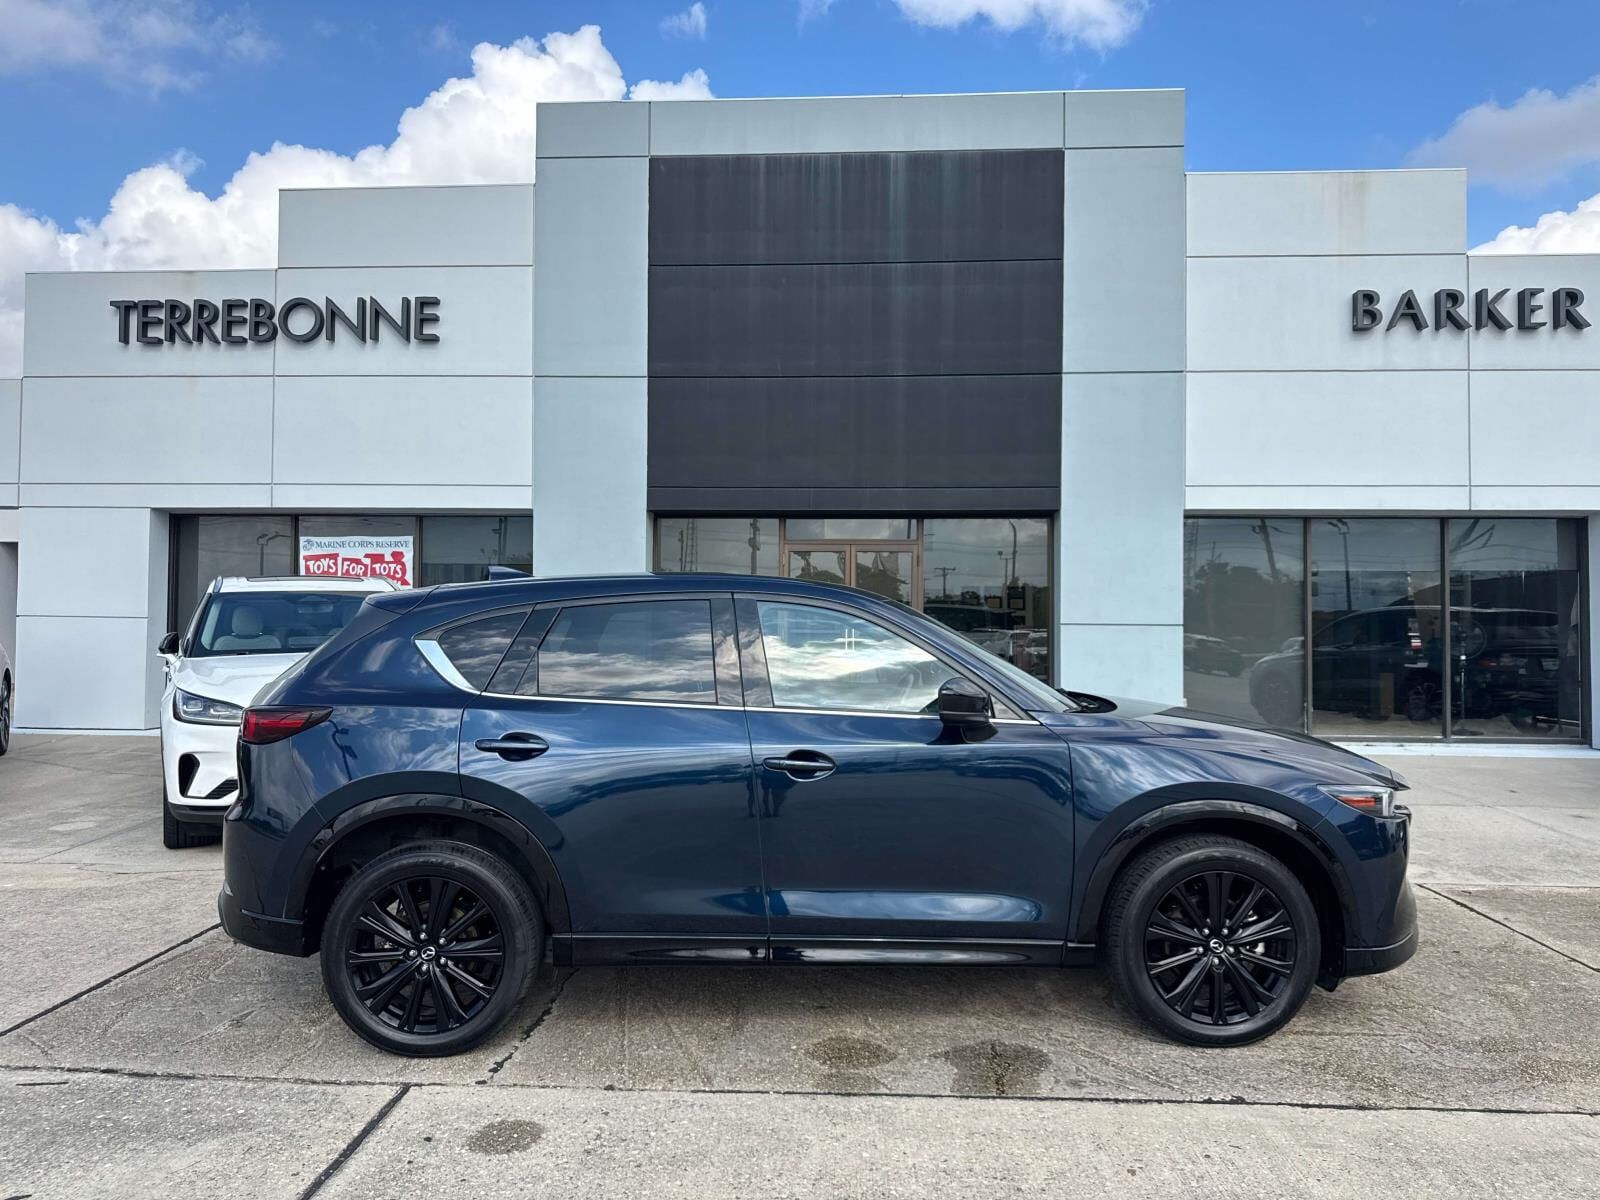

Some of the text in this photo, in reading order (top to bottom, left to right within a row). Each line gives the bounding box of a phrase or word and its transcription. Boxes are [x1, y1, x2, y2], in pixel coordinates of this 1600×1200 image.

[110, 296, 441, 345] TERREBONNE
[1352, 287, 1592, 332] BARKER
[315, 540, 409, 549] MARINE CORPS RESERVE
[306, 558, 402, 578] TOYS FOR TOTS
